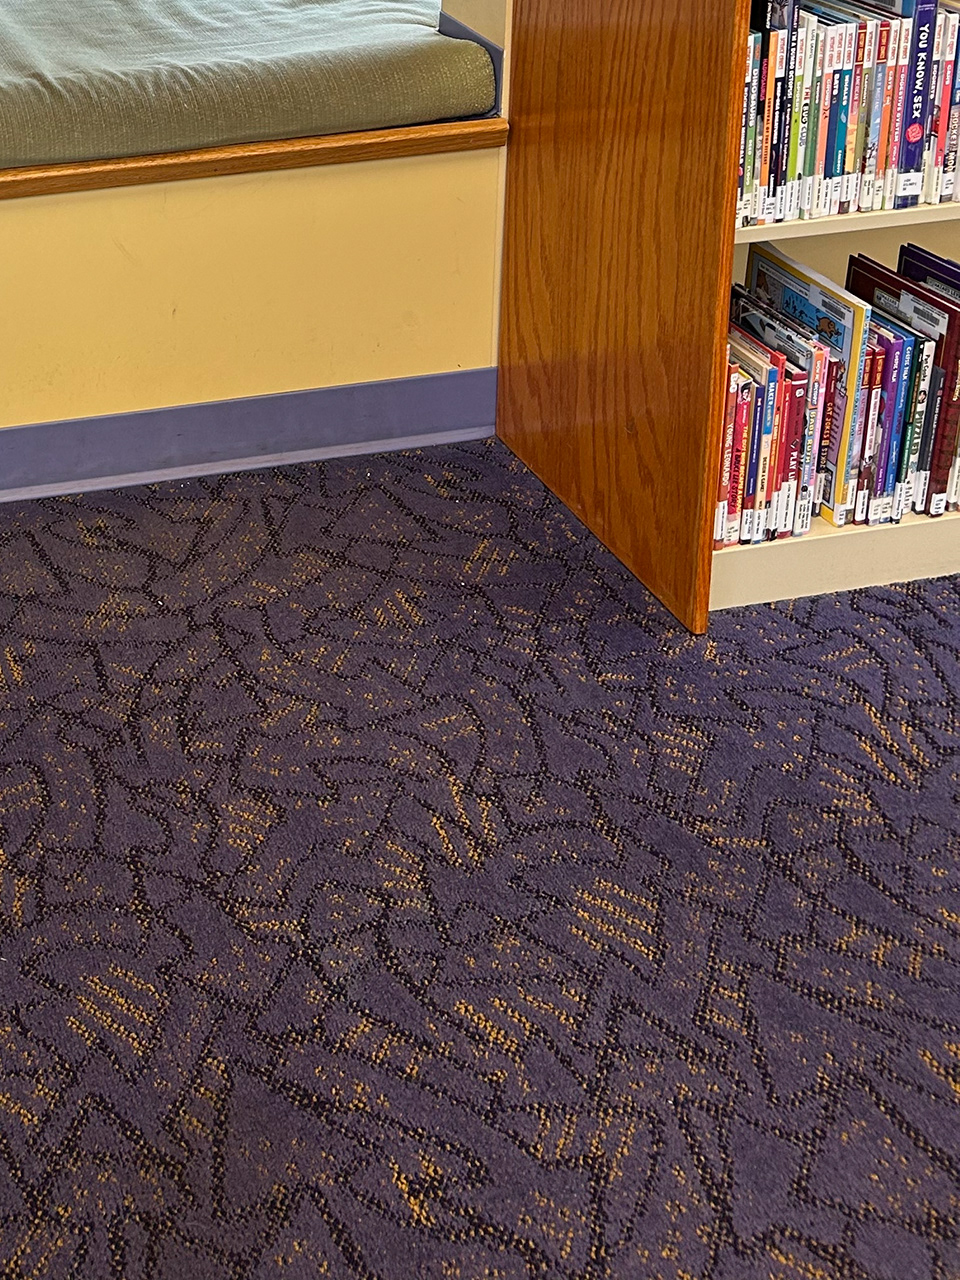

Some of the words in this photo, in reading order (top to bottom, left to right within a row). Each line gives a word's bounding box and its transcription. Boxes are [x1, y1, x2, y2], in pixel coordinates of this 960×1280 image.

[918, 23, 930, 50] YOU
[913, 52, 928, 93] KNOW,
[749, 69, 758, 127] DINOSAURS
[842, 75, 850, 106] WHALES
[911, 94, 923, 119] SEX
[725, 423, 733, 447] YOUNG
[808, 412, 817, 436] BABE
[911, 410, 924, 455] PUZZLED
[789, 451, 798, 472] PLAY
[805, 439, 813, 463] RUTH
[722, 449, 732, 486] LEONARDO
